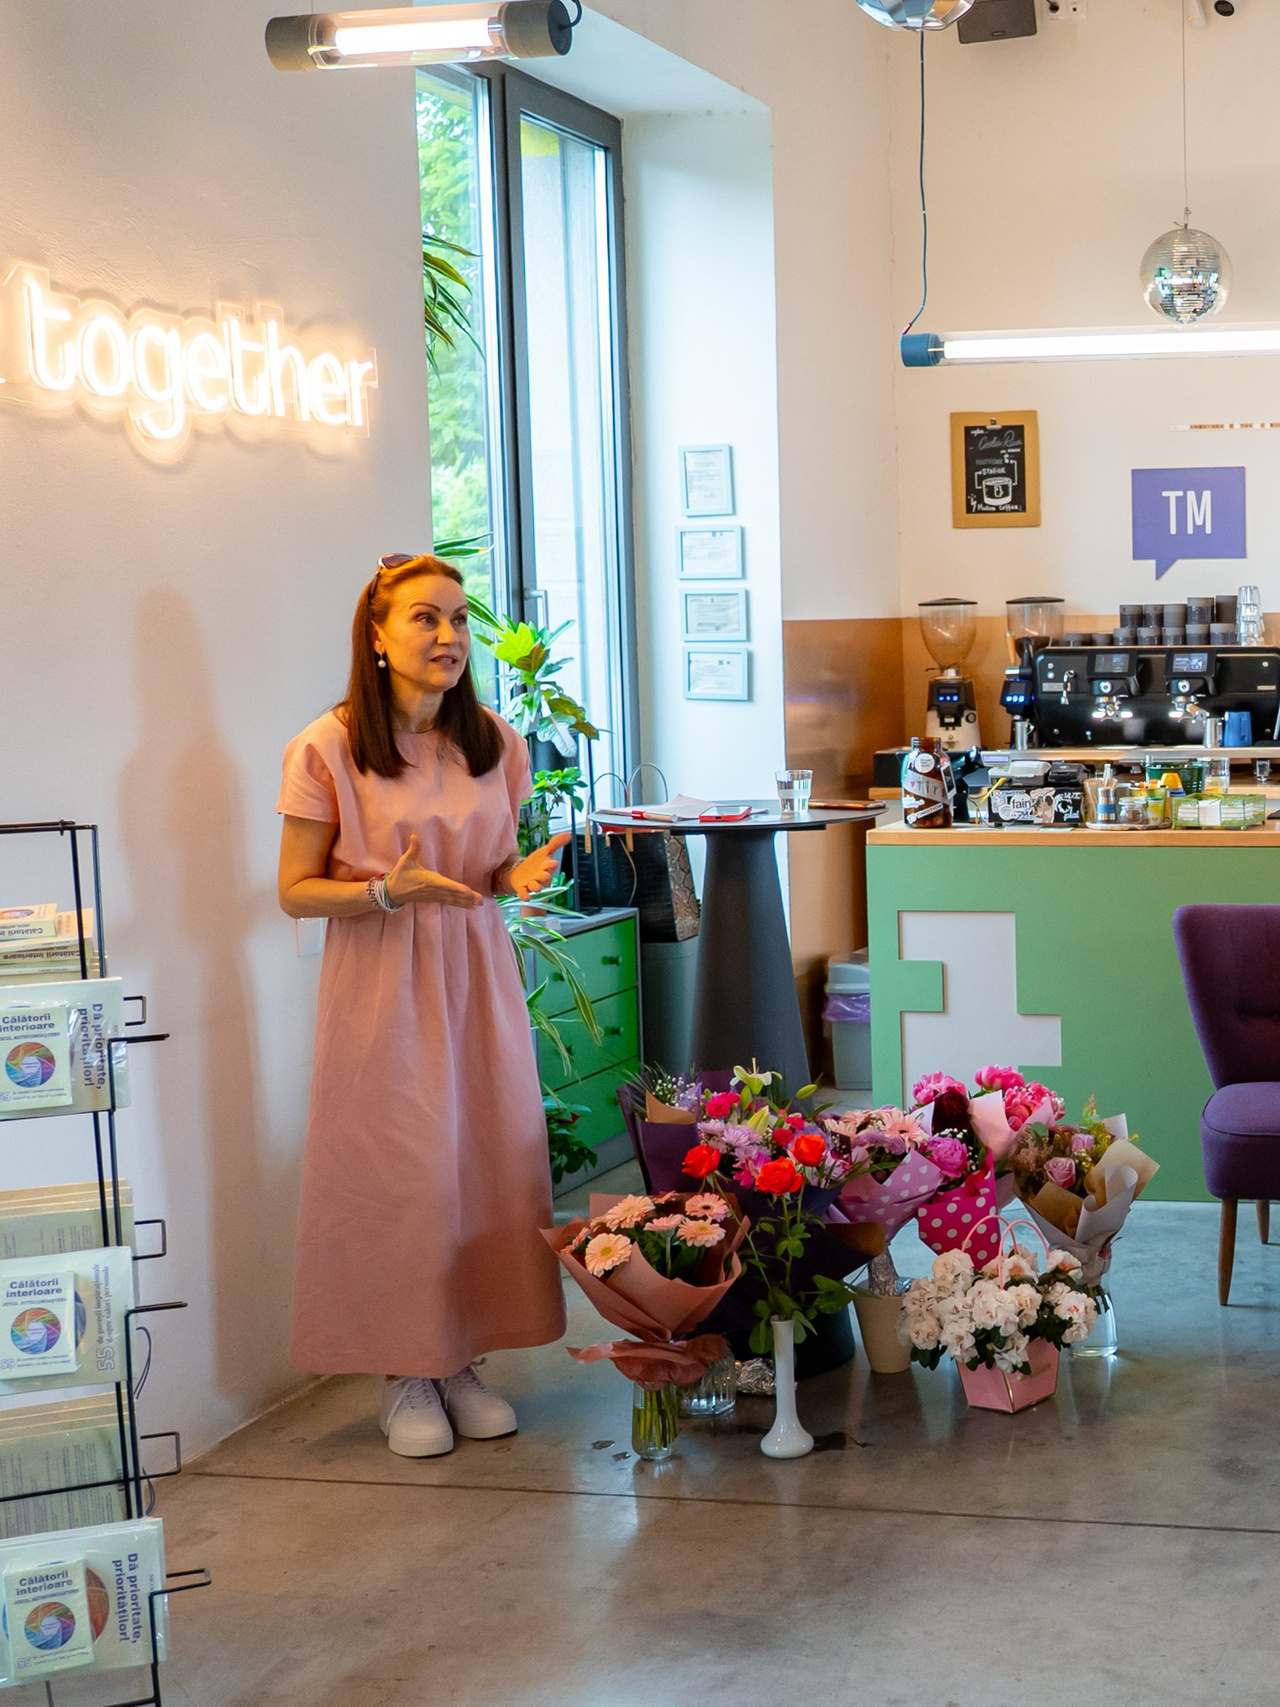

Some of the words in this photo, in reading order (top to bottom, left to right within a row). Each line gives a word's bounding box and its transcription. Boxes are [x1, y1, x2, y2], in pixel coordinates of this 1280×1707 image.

[23, 278, 373, 440] together
[1162, 490, 1211, 535] TM
[0, 1022, 56, 1033] interioare
[2, 1013, 51, 1024] Călătorii
[10, 1277, 59, 1290] Călătorii
[6, 1287, 62, 1299] interioare
[96, 1346, 115, 1371] 55
[127, 1553, 139, 1571] Dă
[19, 1570, 69, 1587] Călătorii
[16, 1579, 73, 1597] interioare
[127, 1575, 143, 1644] prioritate,
